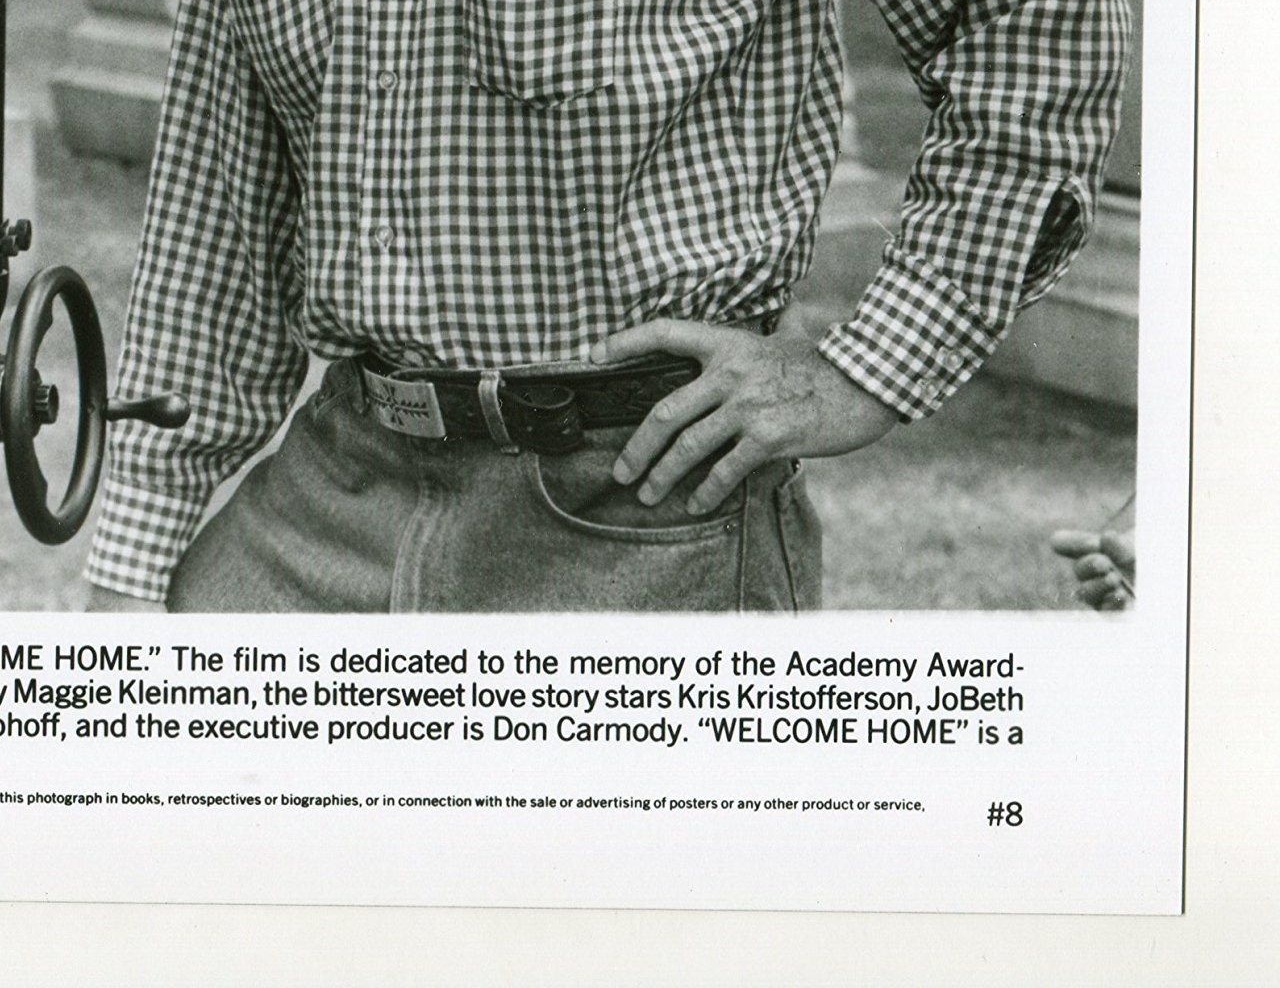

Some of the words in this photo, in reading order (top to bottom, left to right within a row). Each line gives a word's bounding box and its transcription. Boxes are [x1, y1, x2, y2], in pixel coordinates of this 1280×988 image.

[171, 645, 224, 673] The
[233, 646, 287, 673] film
[298, 647, 321, 673] is
[330, 647, 467, 674] dedicated
[477, 649, 505, 675] to
[513, 648, 559, 675] the
[570, 655, 686, 681] memory
[695, 650, 723, 676] of
[730, 650, 776, 677] the
[785, 650, 918, 683] Academy
[926, 651, 1024, 678] Award-
[14, 678, 112, 709] Maggie
[119, 679, 257, 710] Kleinman,
[263, 680, 308, 706] the
[314, 680, 466, 708] bittersweet
[472, 682, 526, 708] love
[531, 683, 600, 714] story
[604, 684, 672, 709] stars
[678, 683, 731, 710] Kris
[737, 683, 921, 715] Kristofferson,
[927, 685, 1023, 712] JoBeth
[75, 712, 127, 738] and
[135, 712, 181, 739] the
[188, 713, 319, 740] executive
[328, 714, 455, 745] producer
[463, 715, 485, 741] is
[493, 715, 548, 742] Don
[556, 715, 689, 748] Carmody.
[978, 719, 1000, 745] is
[1007, 725, 1024, 745] a
[27, 791, 103, 807] photograph
[105, 792, 119, 804] in
[121, 792, 165, 807] books,
[167, 793, 262, 808] retrospectives
[264, 796, 279, 806] or
[280, 793, 363, 808] biographies,
[365, 796, 380, 807] or
[382, 794, 395, 806] in
[397, 795, 472, 808] connection
[474, 795, 503, 808] with
[505, 795, 527, 808] the
[530, 796, 557, 808] sale
[559, 798, 574, 809] or
[576, 796, 651, 811] advertising
[653, 796, 667, 809] of
[669, 797, 718, 811] posters
[720, 799, 735, 810] or
[737, 800, 762, 812] any
[763, 797, 799, 810] other
[802, 798, 854, 812] product
[856, 801, 871, 811] or
[873, 798, 925, 812] service,
[986, 801, 1024, 827] #8
